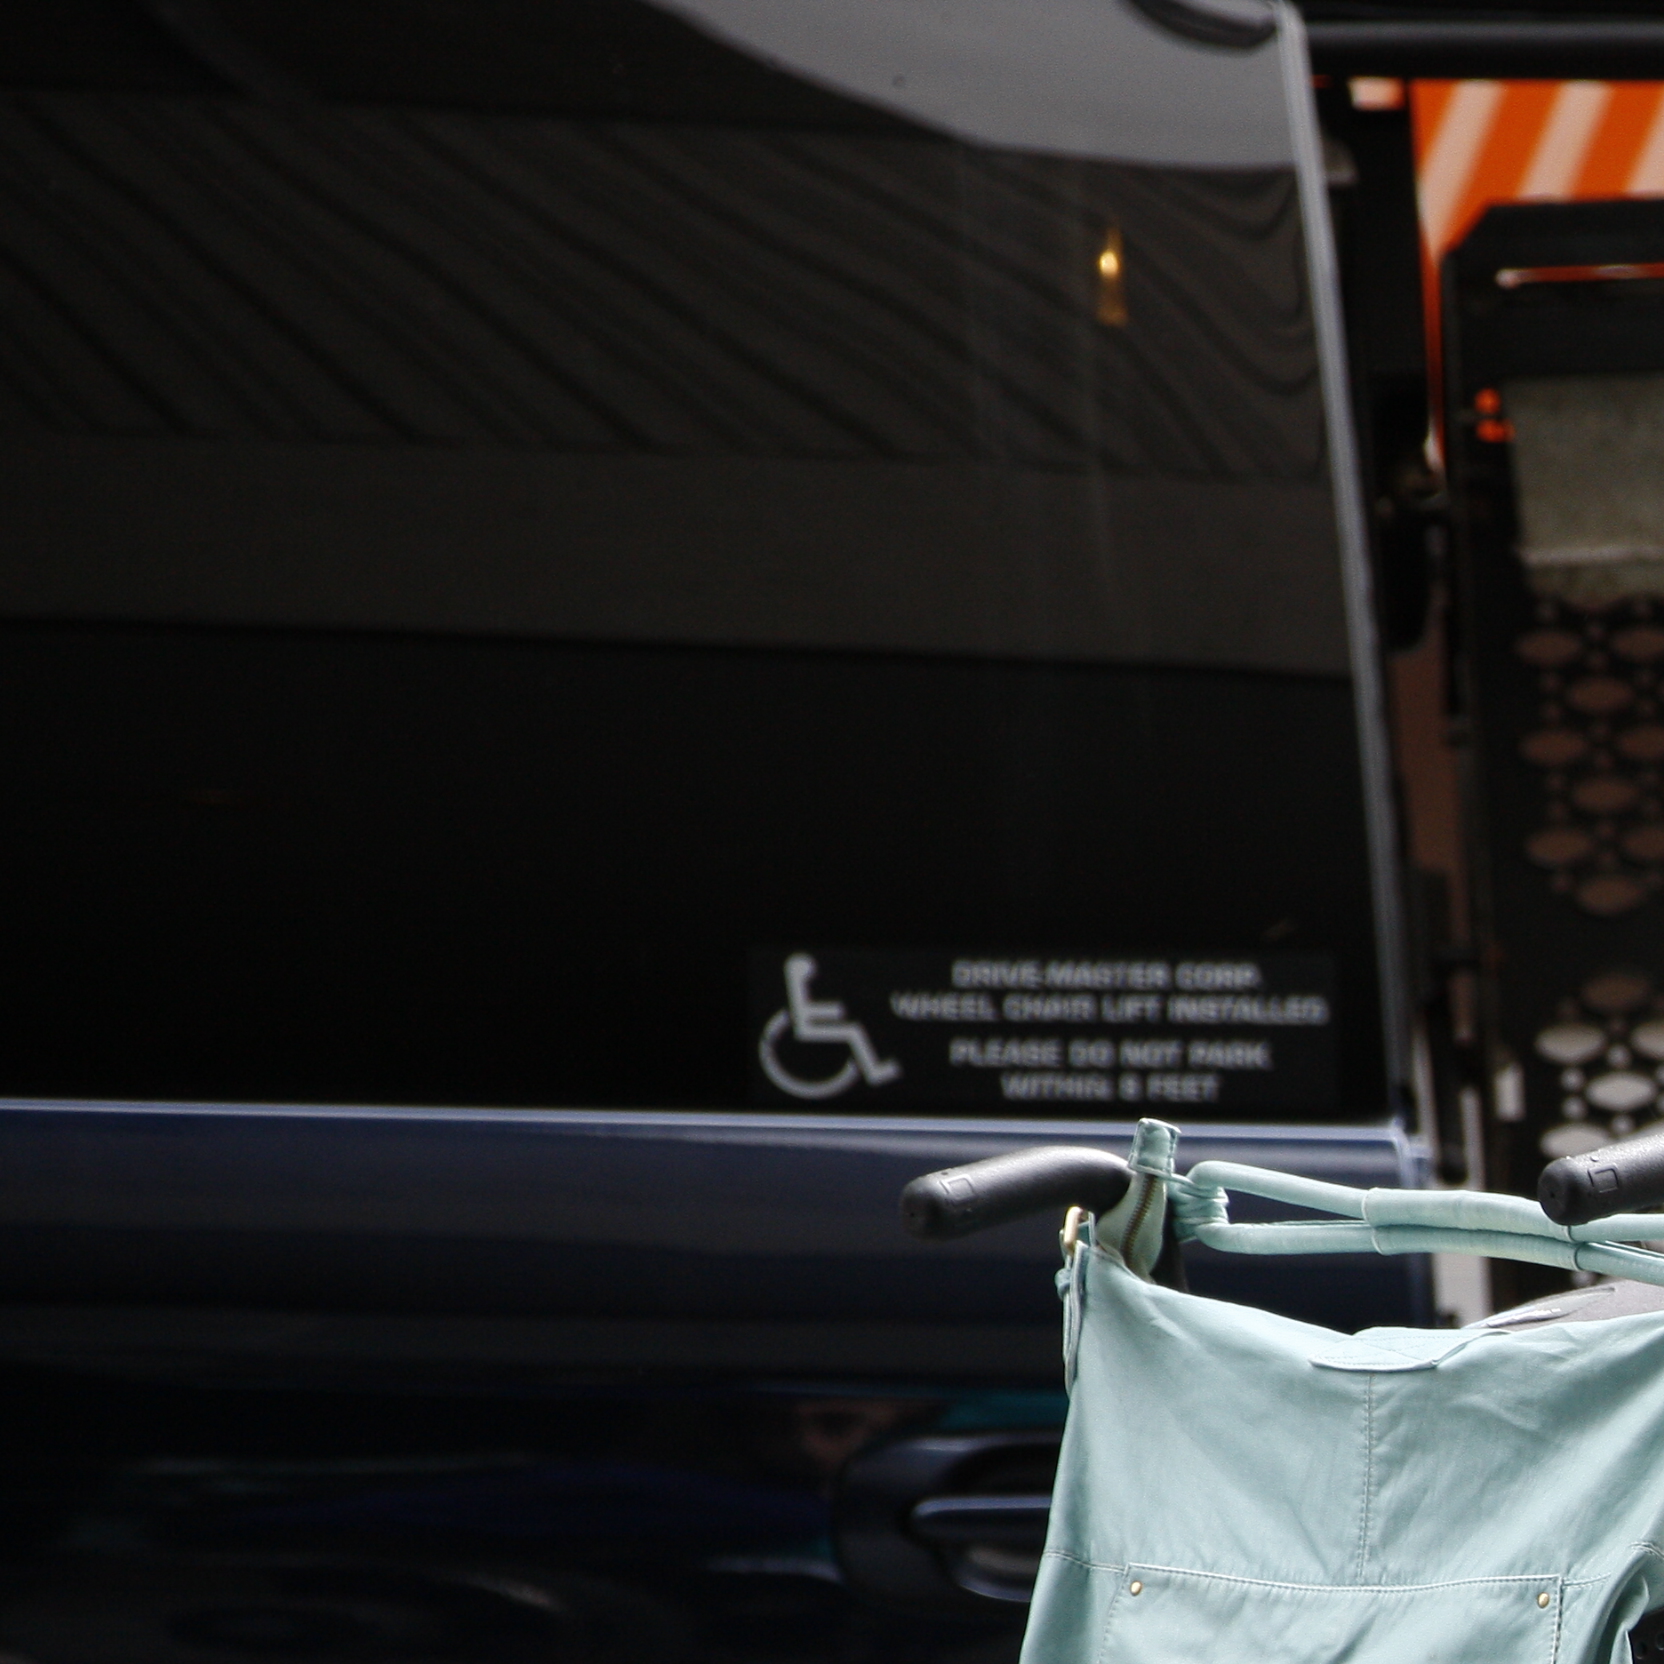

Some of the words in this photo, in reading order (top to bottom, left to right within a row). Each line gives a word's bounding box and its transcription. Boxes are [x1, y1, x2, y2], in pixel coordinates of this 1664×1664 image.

[891, 993, 998, 1021] WHEEL
[1003, 994, 1095, 1022] CHAIR
[1101, 995, 1161, 1023] LIFT
[1167, 996, 1329, 1025] INSTALLED
[950, 1038, 1063, 1068] PLEASE
[1068, 1038, 1114, 1068] DO
[1119, 1039, 1182, 1069] NOT
[1188, 1040, 1272, 1070] PARK
[1002, 1071, 1112, 1099] WITHIN
[1147, 1073, 1219, 1101] FEET
